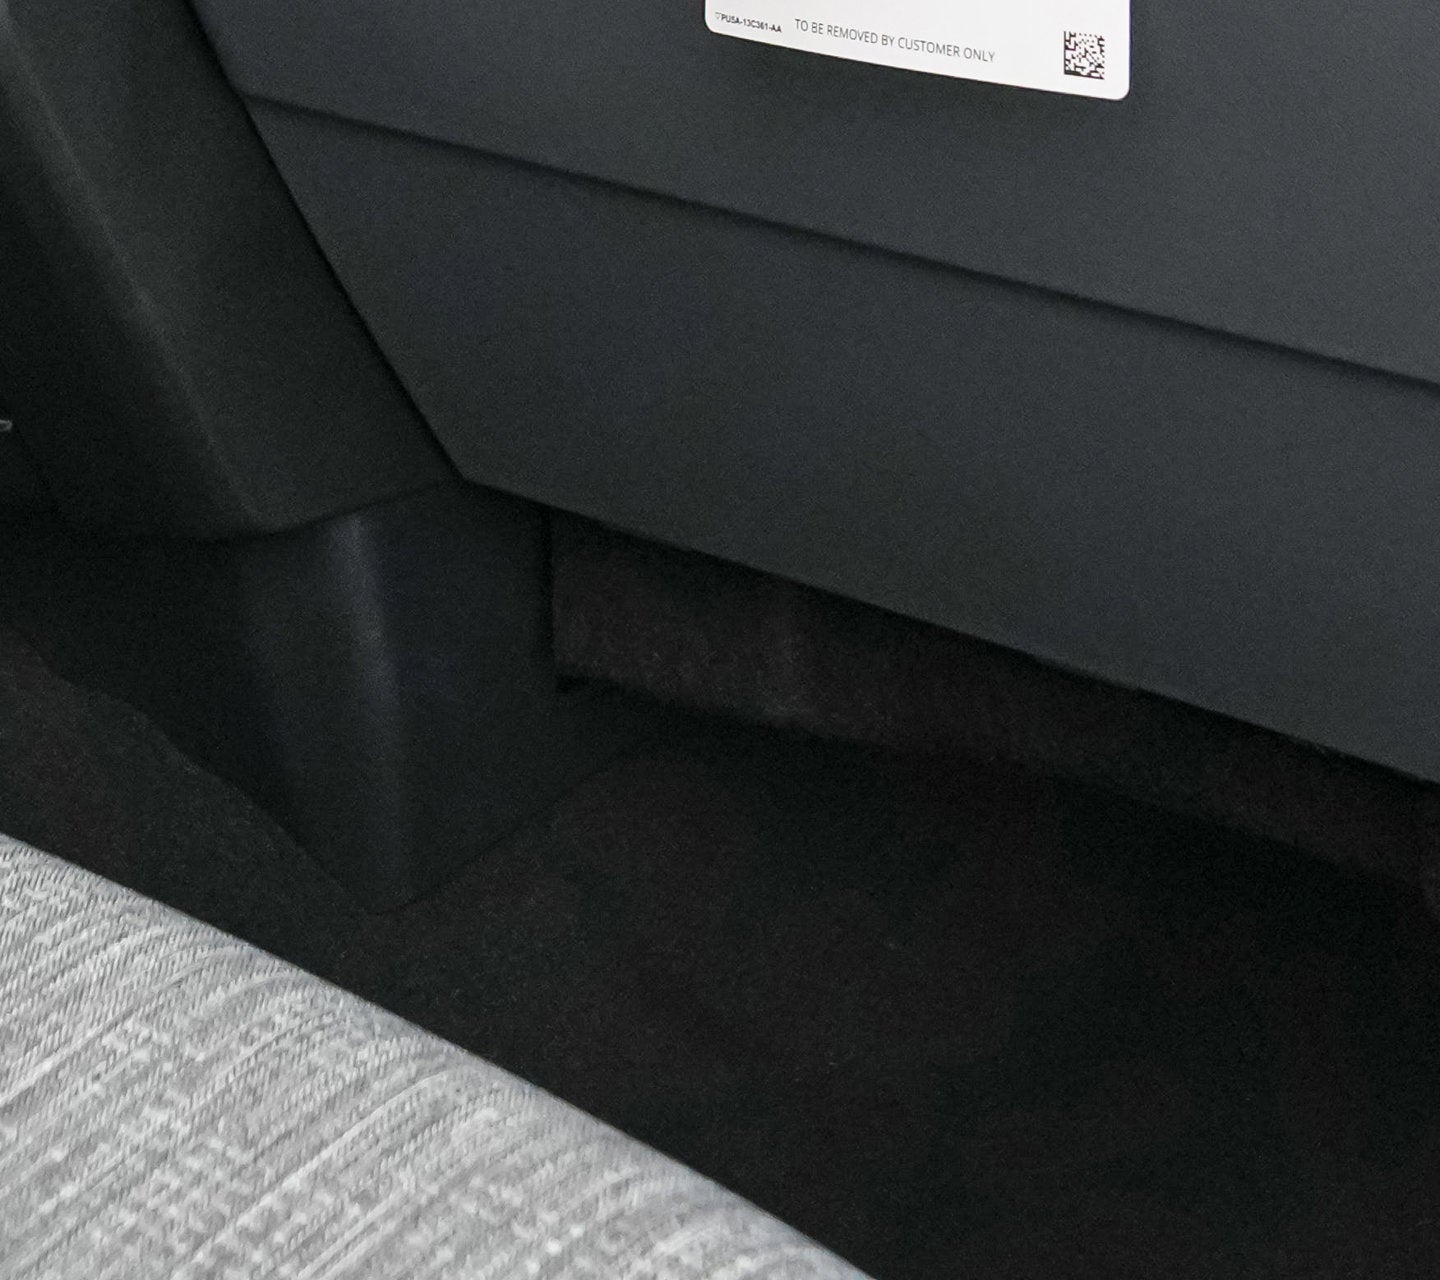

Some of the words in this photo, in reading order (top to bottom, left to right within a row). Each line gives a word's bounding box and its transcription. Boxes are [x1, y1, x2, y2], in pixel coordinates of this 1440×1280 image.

[794, 18, 809, 32] TO
[811, 22, 824, 35] BE
[827, 24, 879, 44] REMOVED
[881, 34, 895, 47] BY
[897, 36, 960, 58] CUSTOMER
[963, 47, 996, 63] ONLY
